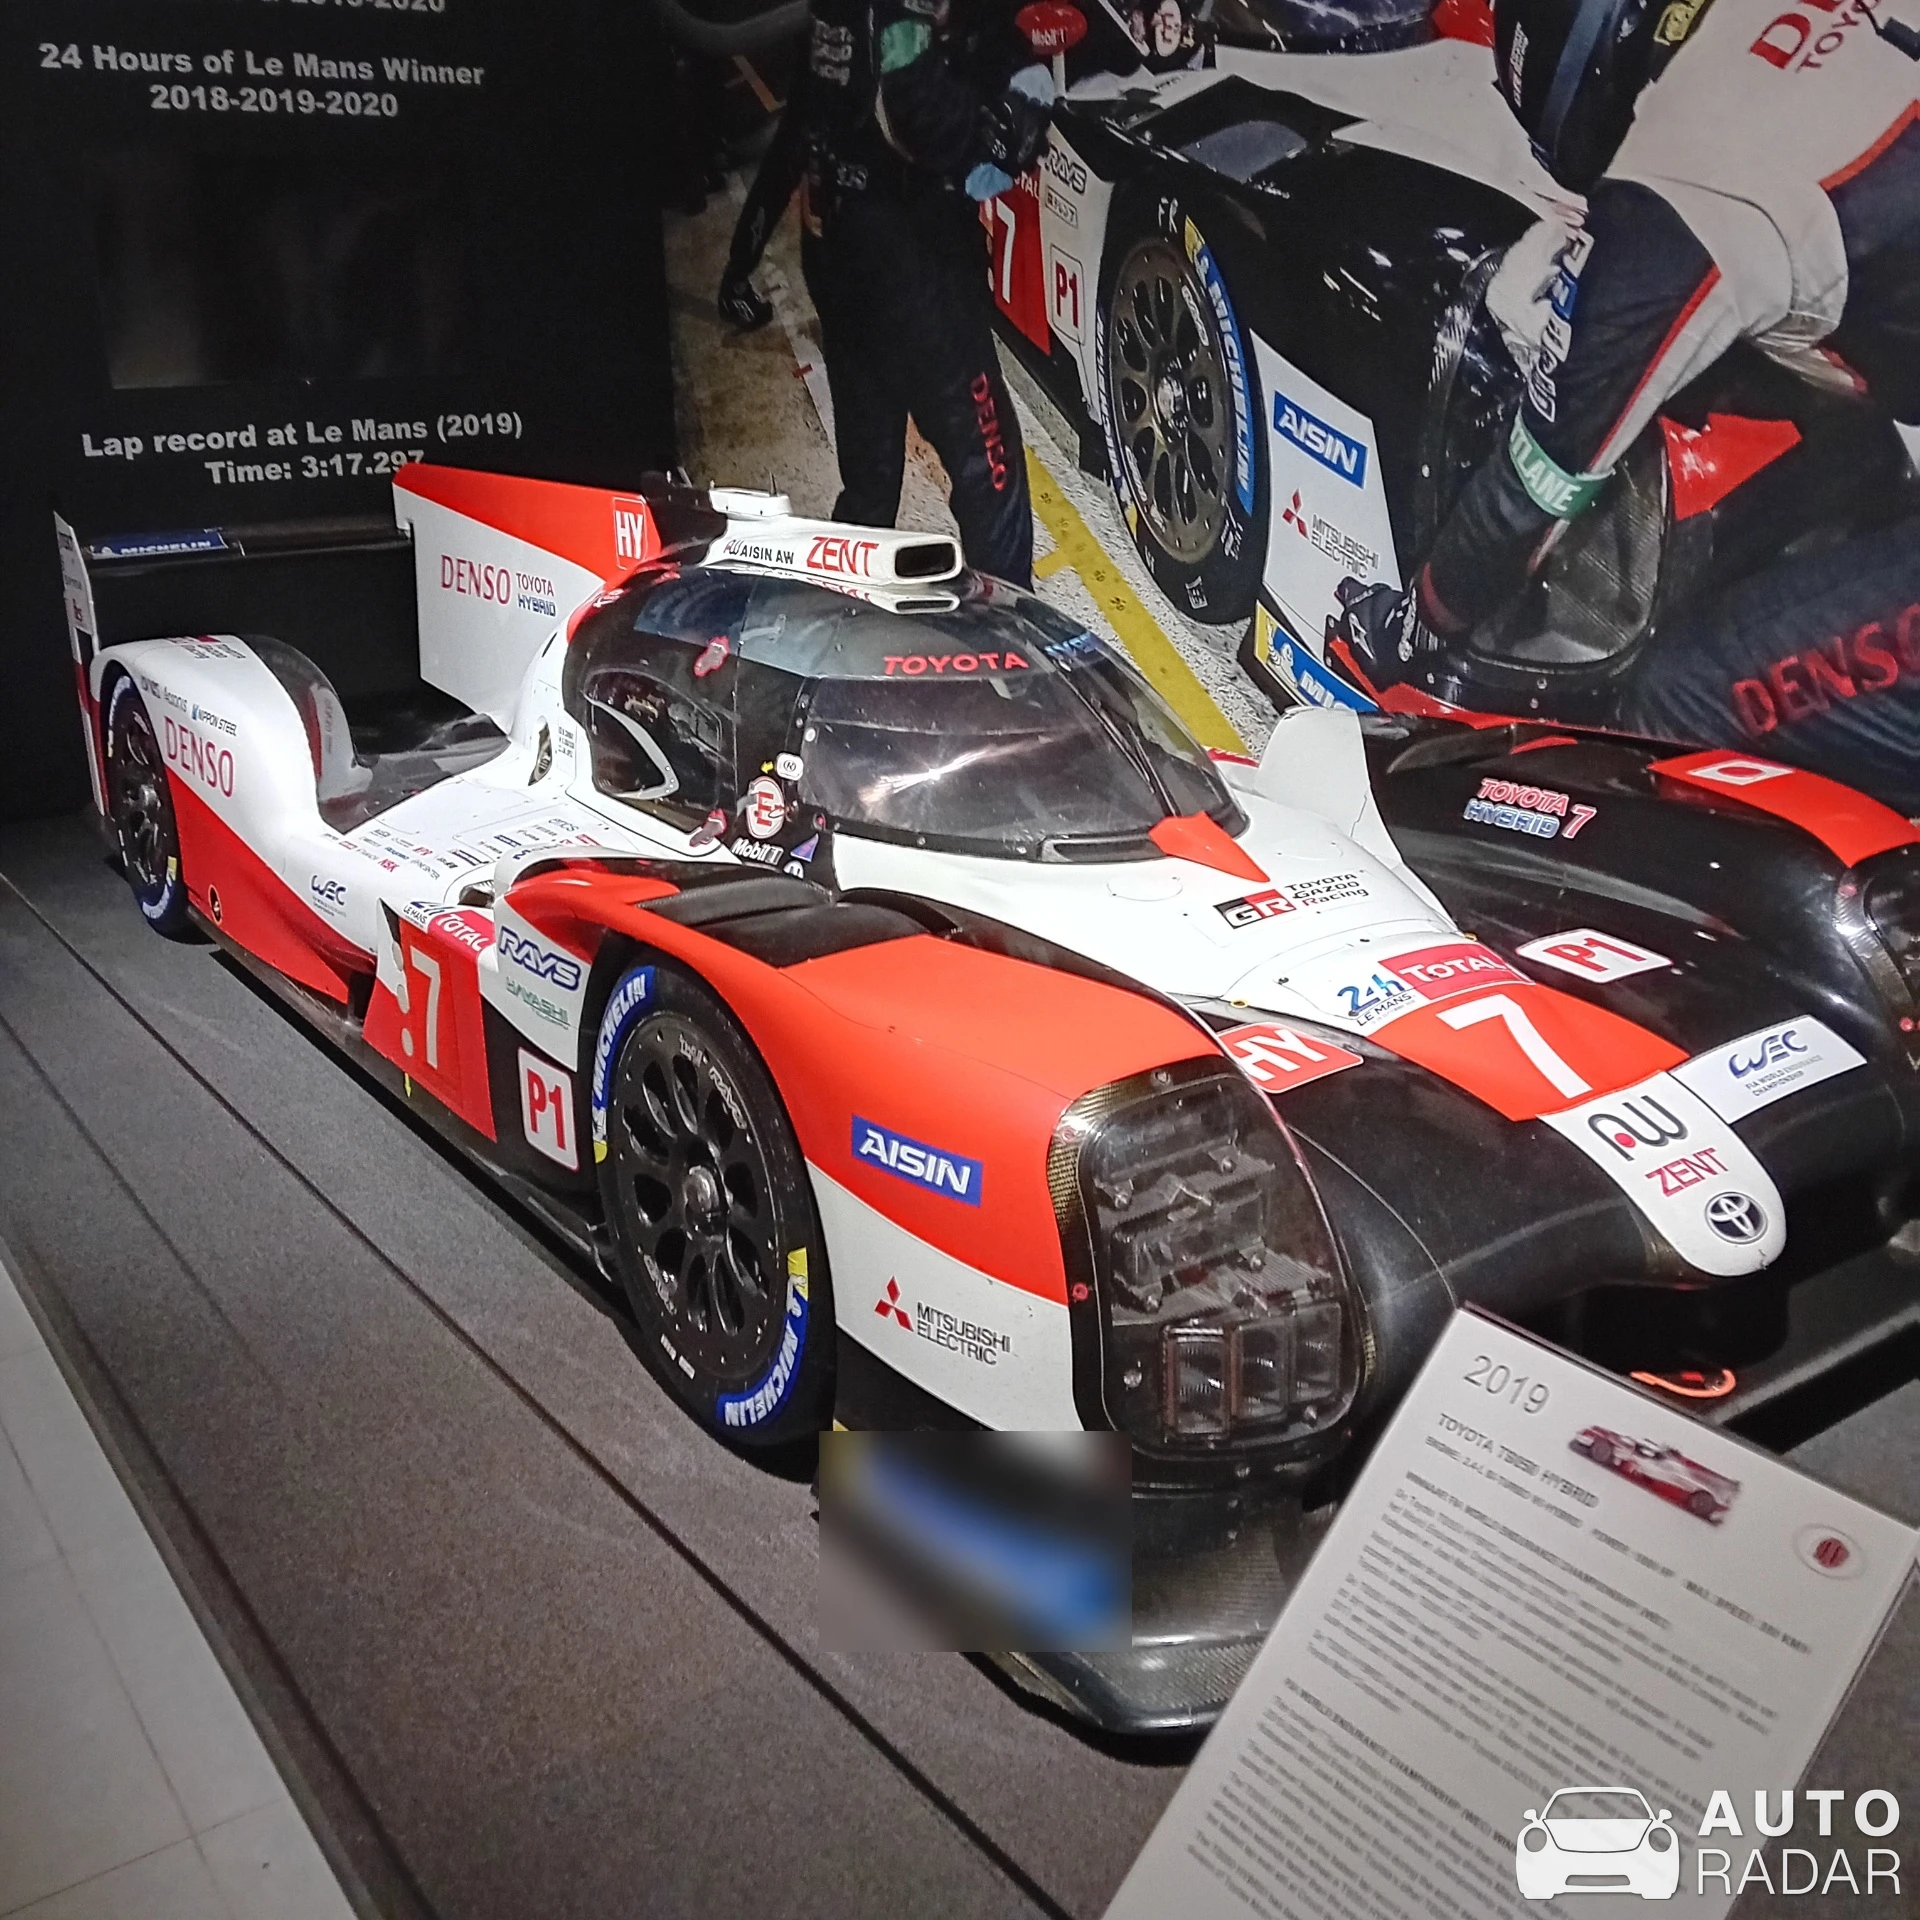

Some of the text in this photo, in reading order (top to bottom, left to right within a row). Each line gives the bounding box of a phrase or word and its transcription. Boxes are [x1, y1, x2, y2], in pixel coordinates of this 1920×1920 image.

[1031, 28, 1057, 47] Mobil
[38, 43, 485, 85] 24 Hours of Le Mans Winner
[150, 84, 398, 117] 2018-2019-2020
[1044, 145, 1087, 195] RAYS
[996, 196, 1015, 304] 7
[1055, 261, 1079, 329] P1
[1208, 281, 1250, 492] MICHELIN
[81, 411, 523, 460] Lap record at Le Mans (2019)
[1278, 404, 1358, 474] AISIN
[204, 460, 292, 485] Time:
[615, 511, 644, 560] HY
[742, 547, 772, 562] AISIN
[775, 551, 794, 565] AW
[806, 536, 879, 577] ZENT
[1311, 531, 1368, 578] ELECTRIC
[1312, 513, 1379, 569] MITSUBISHI
[441, 554, 511, 605] DENSO
[515, 572, 555, 597] TOYOTA
[517, 593, 556, 617] HYBRID
[883, 651, 1030, 676] TOYOTA
[217, 718, 237, 737] STEEL
[164, 715, 234, 798] DENSO
[1463, 798, 1560, 838] HYBRID
[1476, 777, 1570, 817] TOYOTA
[1562, 804, 1598, 839] 7
[731, 837, 768, 861] Mobil
[311, 875, 347, 906] WEC
[1284, 873, 1358, 892] TOYOTA
[1292, 881, 1360, 899] GAZOO
[1302, 889, 1370, 906] Racing
[1215, 890, 1296, 929] GR
[437, 913, 490, 952] TOTAL
[500, 926, 581, 992] RAYS
[1399, 954, 1507, 982] TOTAL
[1542, 937, 1648, 973] P1
[410, 945, 441, 1071] 7
[1337, 974, 1405, 1017] 24h
[593, 973, 646, 1101] MICHELIN
[1356, 1012, 1374, 1027] LE
[1233, 1028, 1329, 1082] HY
[1435, 993, 1594, 1100] 7
[1728, 1030, 1809, 1079] WEC
[1759, 1068, 1786, 1087] WORLD
[526, 1067, 566, 1151] P1
[859, 1128, 972, 1195] AISIN
[1644, 1147, 1729, 1198] ZENT
[916, 1301, 1011, 1353] MITSUBISHI
[916, 1319, 998, 1366] ELECTRIC
[724, 1319, 799, 1427] MICHELIN
[1463, 1354, 1550, 1415] 2019
[1438, 1412, 1494, 1455] TOYOTA
